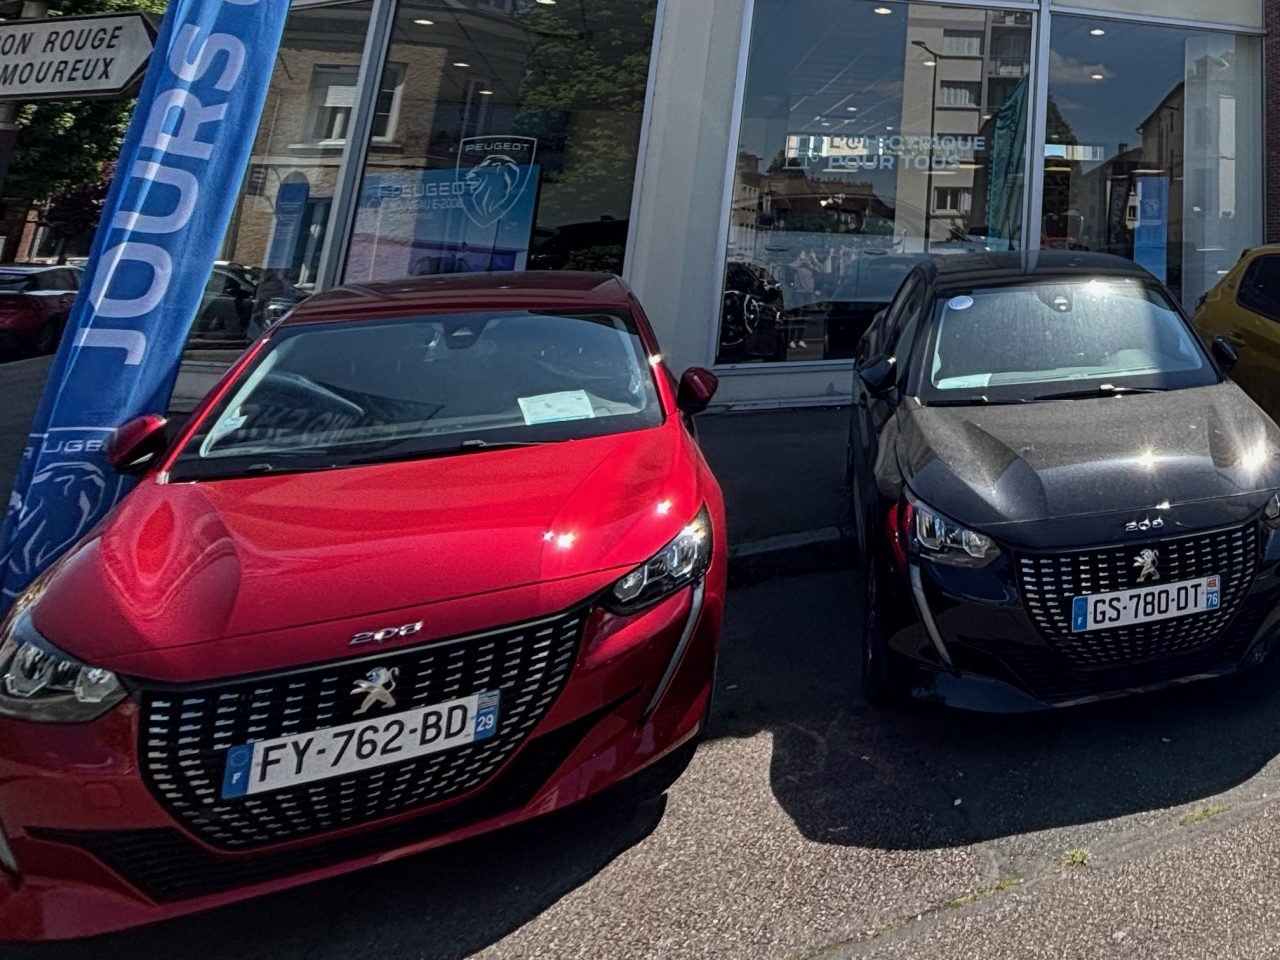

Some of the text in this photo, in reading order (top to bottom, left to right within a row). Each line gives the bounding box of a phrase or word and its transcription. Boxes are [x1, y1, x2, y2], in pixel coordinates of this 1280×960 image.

[42, 26, 123, 53] ROUGE
[465, 142, 530, 152] PEUGEOT
[829, 154, 961, 171] POUR TOUS
[74, 24, 245, 365] JOURS
[1077, 583, 1218, 626] F GS-780-DT 76
[231, 703, 495, 785] F FY-762-BD 29
